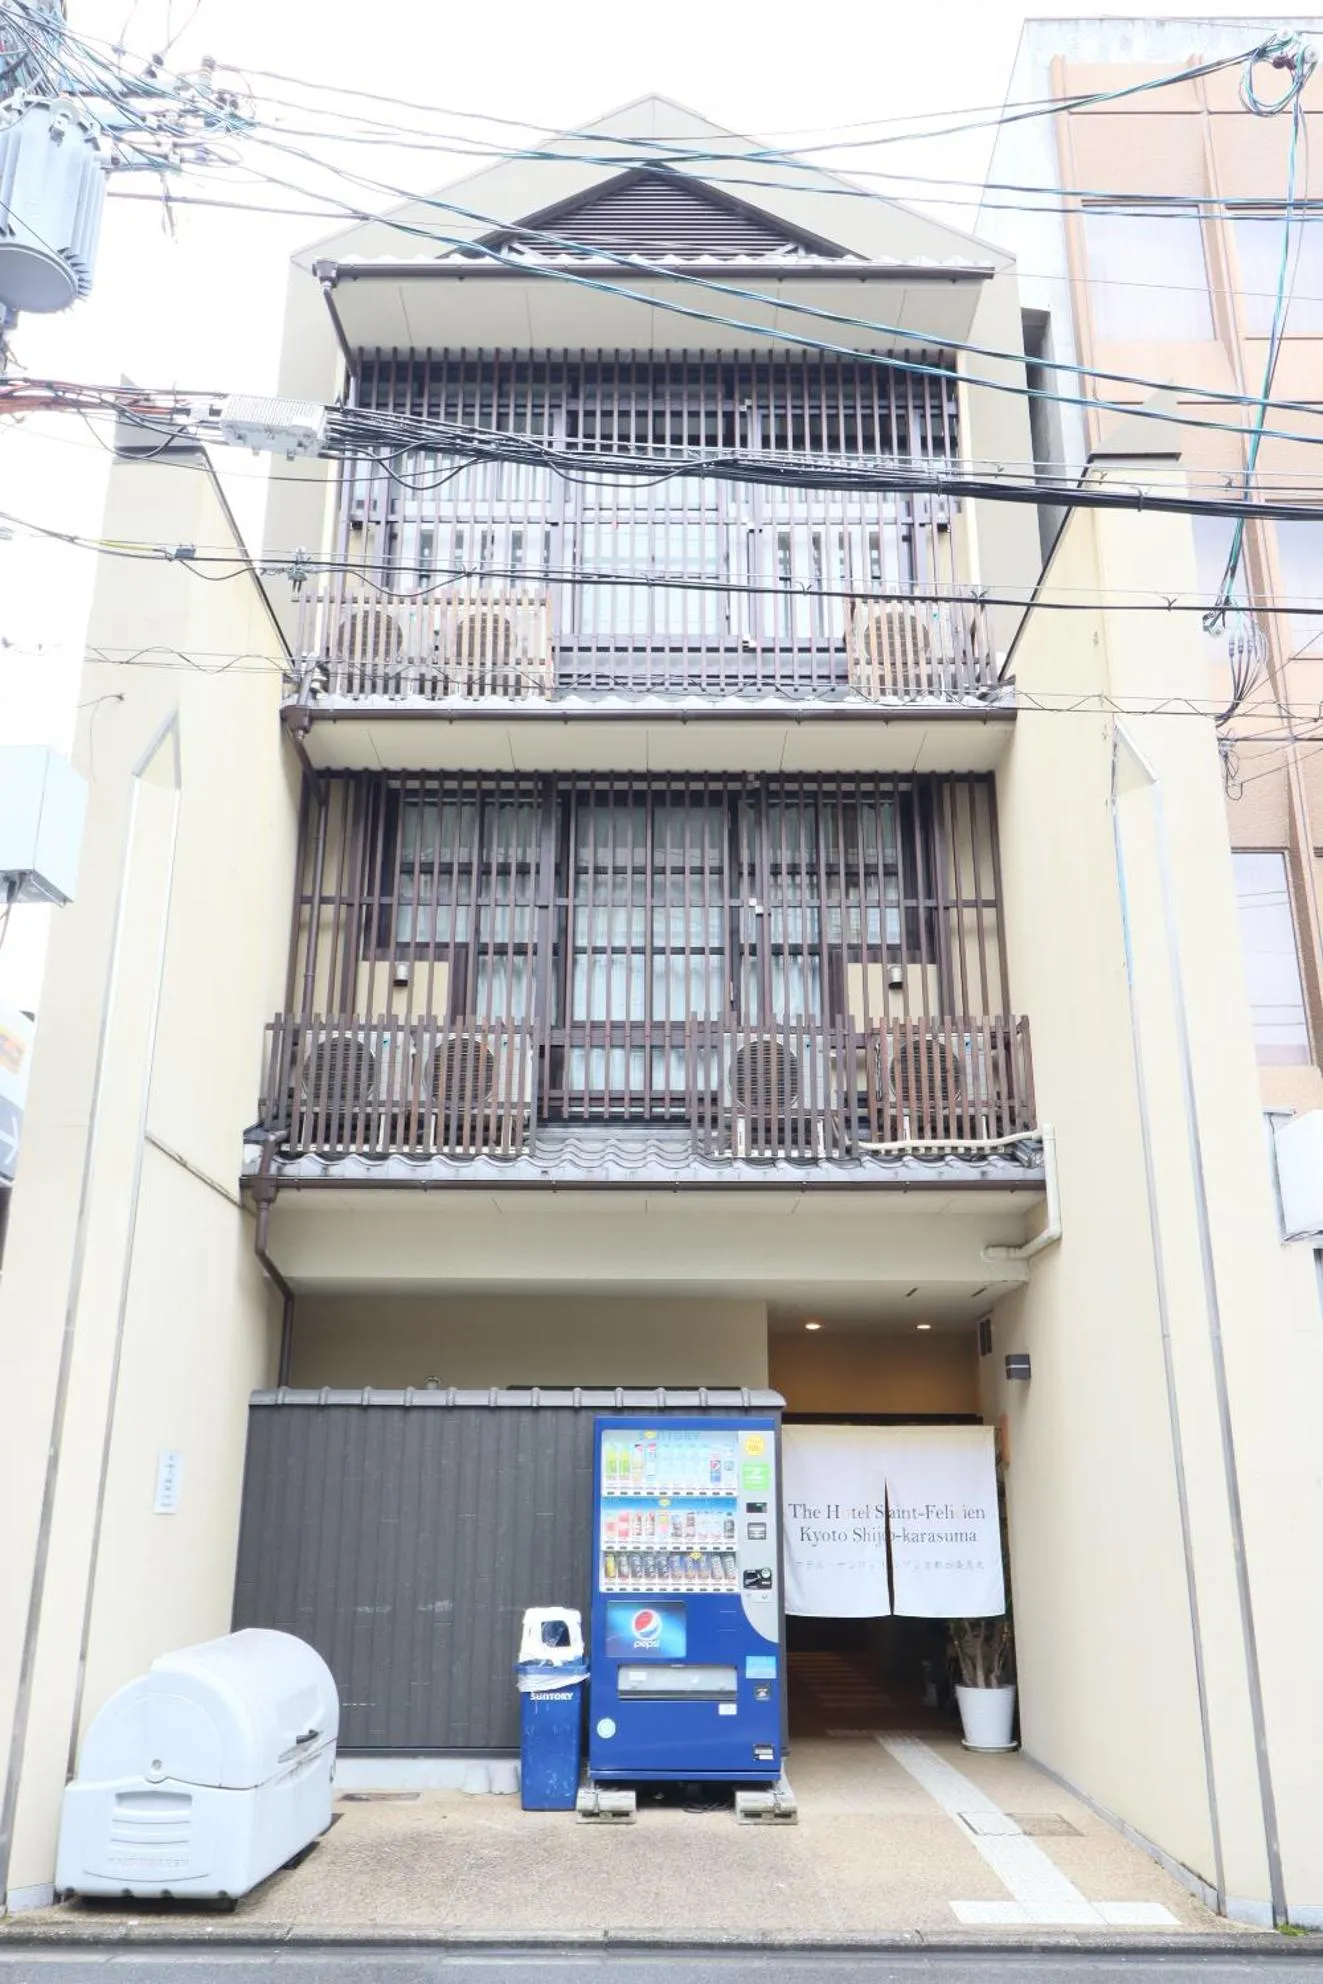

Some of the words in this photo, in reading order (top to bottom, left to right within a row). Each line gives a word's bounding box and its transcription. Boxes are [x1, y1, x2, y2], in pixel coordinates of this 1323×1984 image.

[788, 1503, 821, 1520] The
[826, 1503, 870, 1520] Htel
[875, 1503, 985, 1521] Saint-Feliien
[800, 1526, 848, 1547] Kyoto
